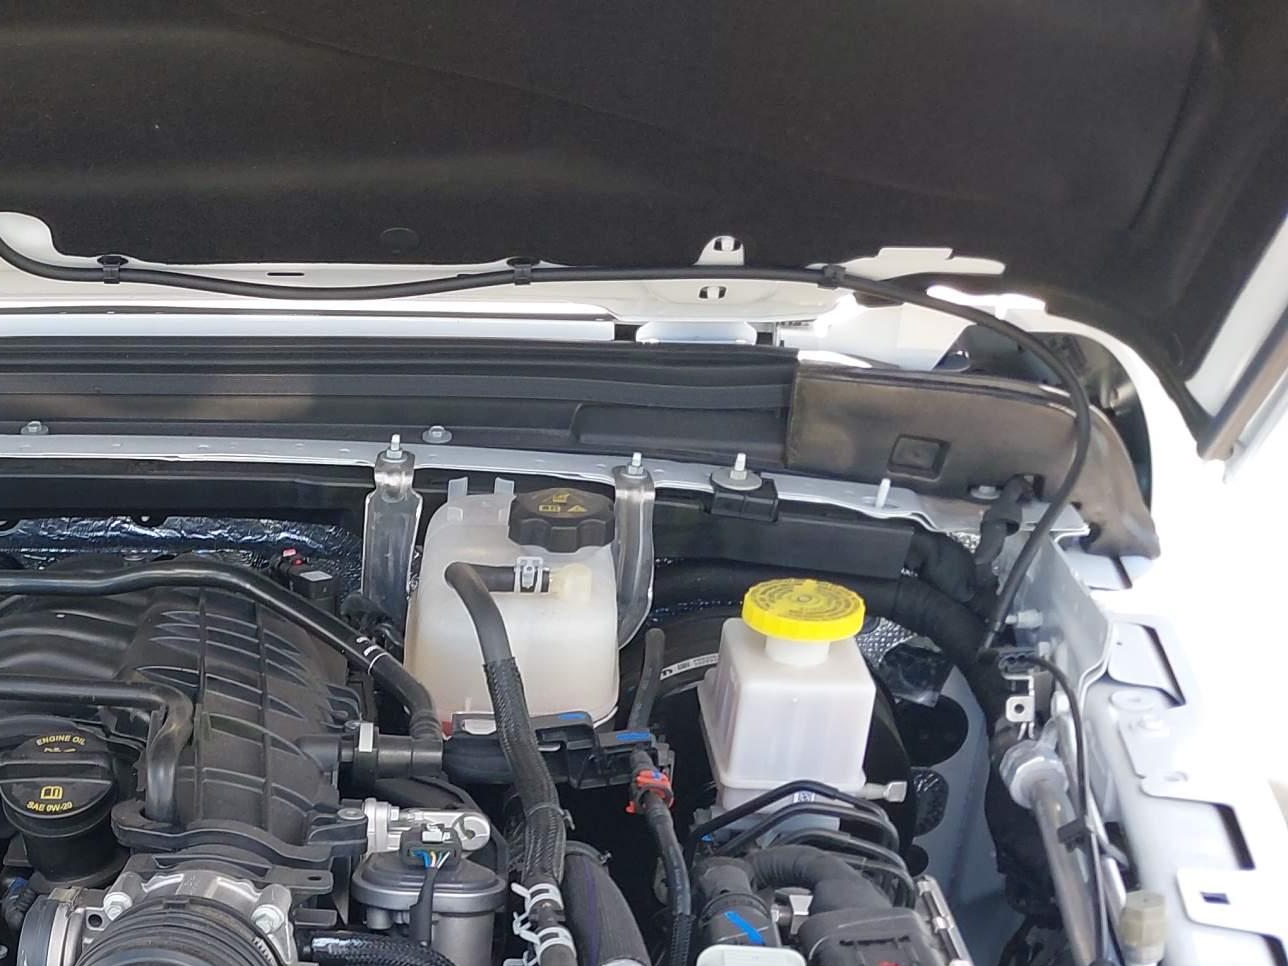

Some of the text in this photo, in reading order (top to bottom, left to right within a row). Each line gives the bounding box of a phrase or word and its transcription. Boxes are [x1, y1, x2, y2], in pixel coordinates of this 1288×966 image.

[36, 735, 86, 746] ENGINE OIL
[27, 800, 73, 812] SAE 0W-20
